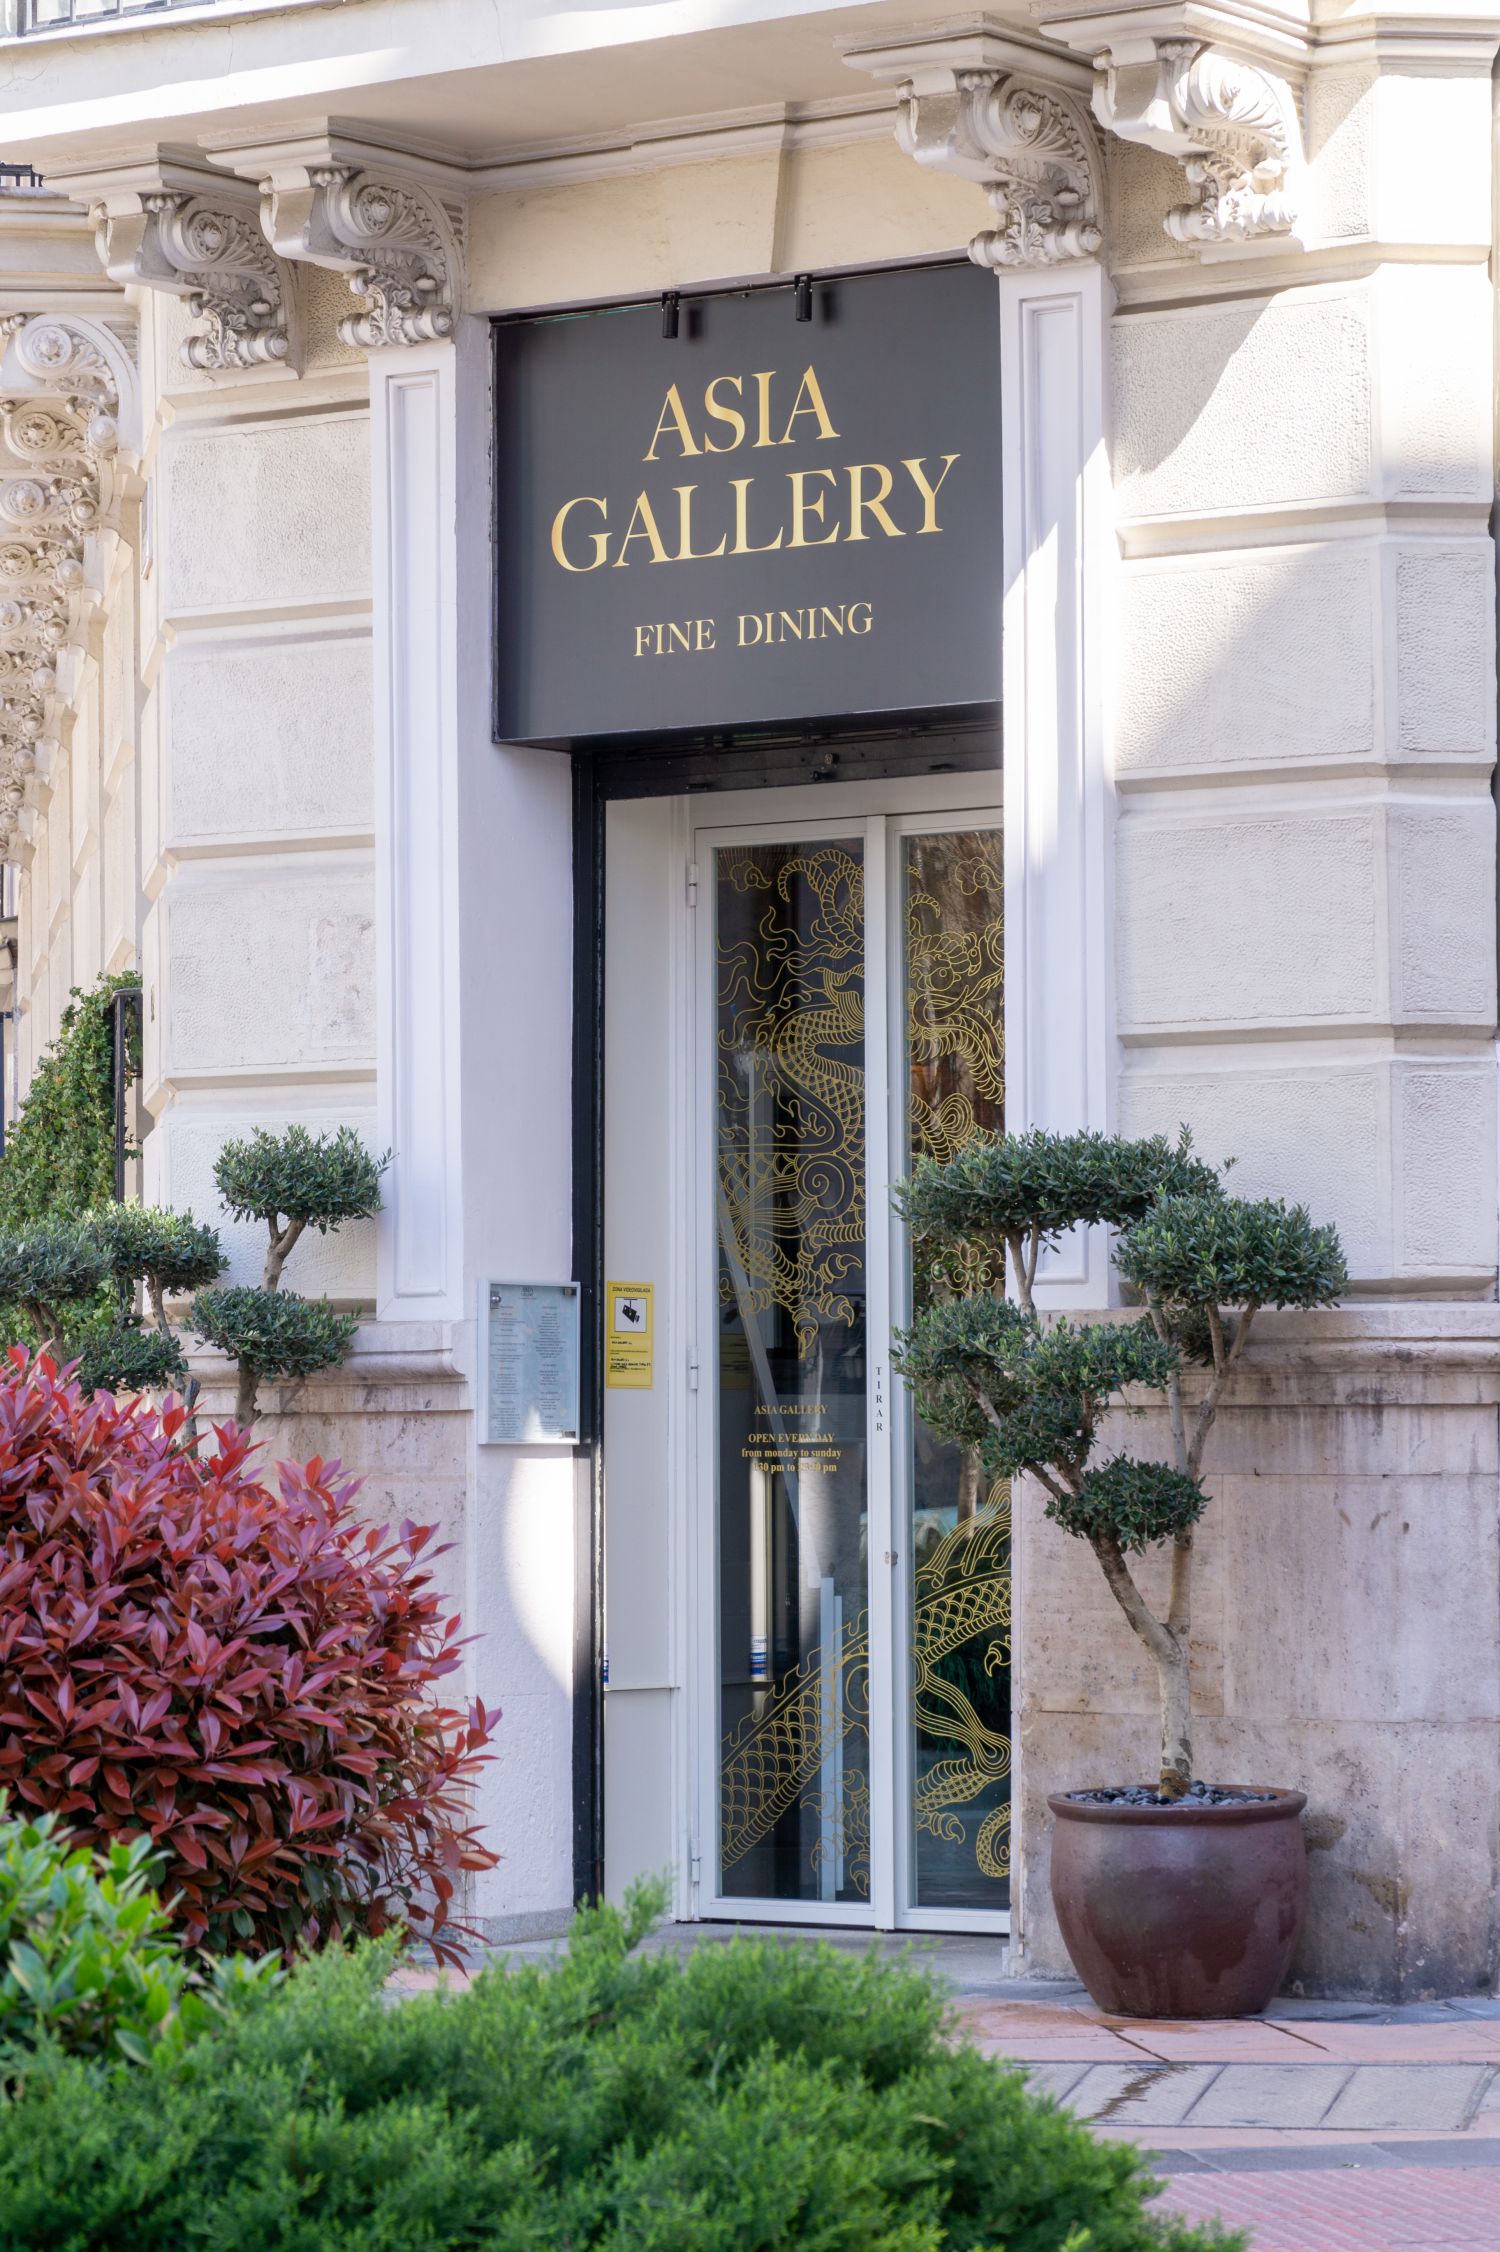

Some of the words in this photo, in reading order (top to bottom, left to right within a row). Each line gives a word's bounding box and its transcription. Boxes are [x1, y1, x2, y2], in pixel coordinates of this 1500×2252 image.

[641, 365, 841, 462] ASIA
[551, 454, 961, 573] GALLERY
[633, 618, 716, 657] FINE
[737, 602, 874, 648] DINING
[754, 1405, 777, 1415] ASIA
[780, 1405, 828, 1415] GALLERY
[875, 1366, 884, 1432] TIRAR
[741, 1448, 762, 1457] from
[764, 1448, 798, 1460] monday
[800, 1449, 809, 1457] to
[811, 1448, 842, 1460] sunday
[748, 1433, 775, 1443] OPEN
[771, 1464, 785, 1474] pm
[787, 1463, 796, 1472] to
[823, 1463, 837, 1474] pm
